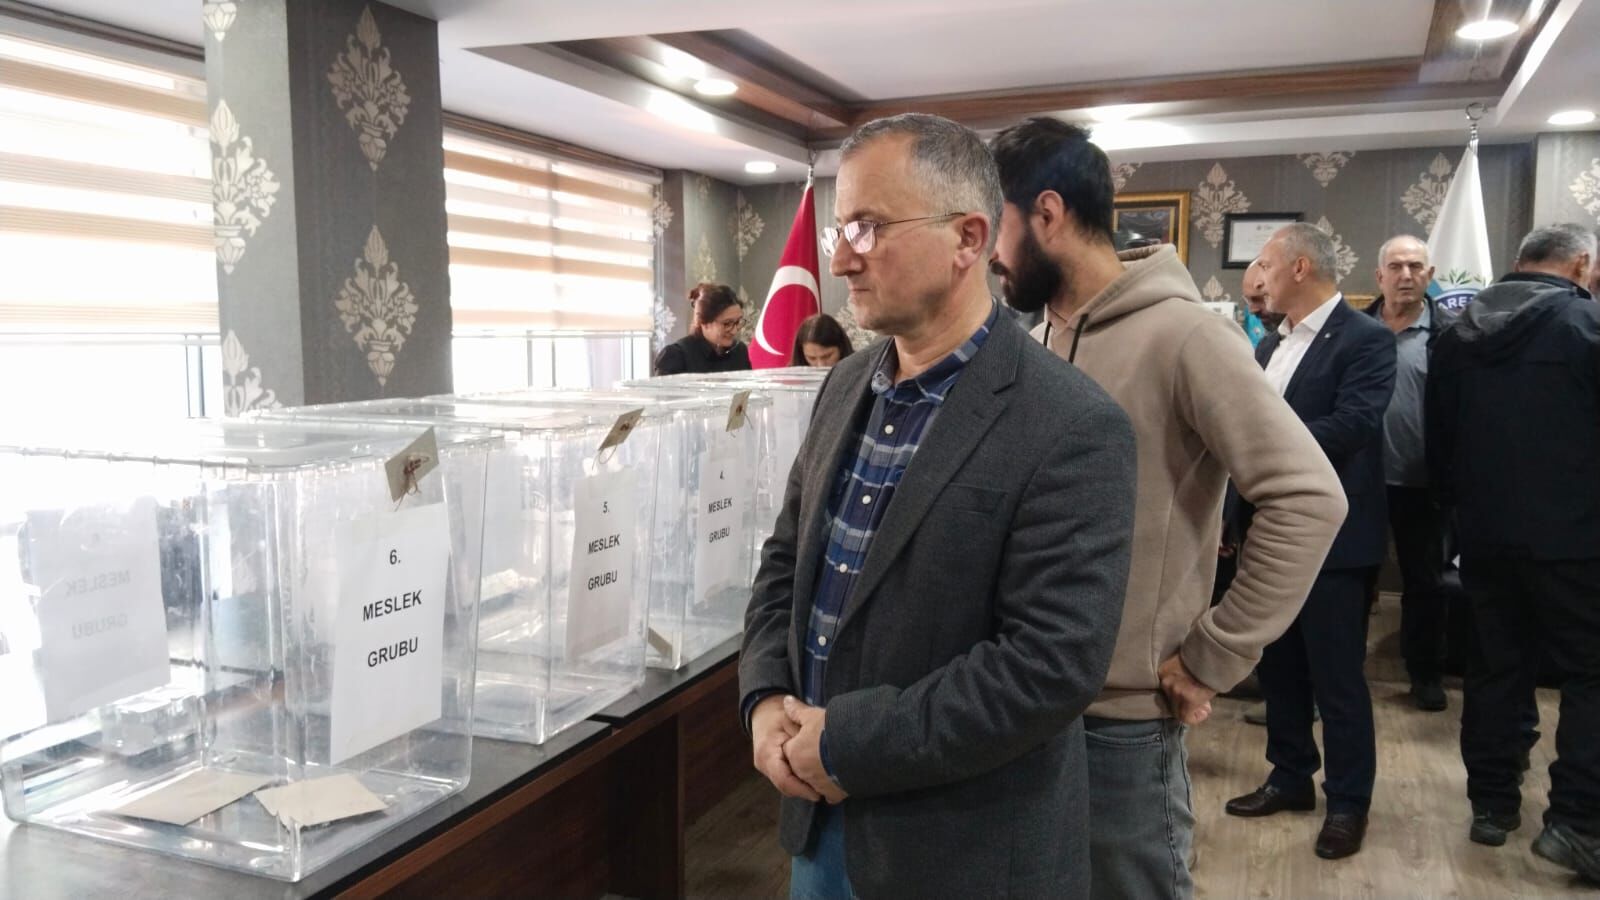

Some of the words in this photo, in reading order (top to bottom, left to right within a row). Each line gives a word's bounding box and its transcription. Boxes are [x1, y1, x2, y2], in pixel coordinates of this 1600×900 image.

[603, 501, 610, 514] 5.
[708, 498, 733, 514] MESLEK
[588, 534, 620, 554] MESLEK
[709, 527, 731, 543] GRUBU
[389, 549, 401, 565] 6.
[588, 570, 618, 591] GRUBU
[363, 589, 422, 621] MESLEK
[367, 637, 419, 667] GRUBU
